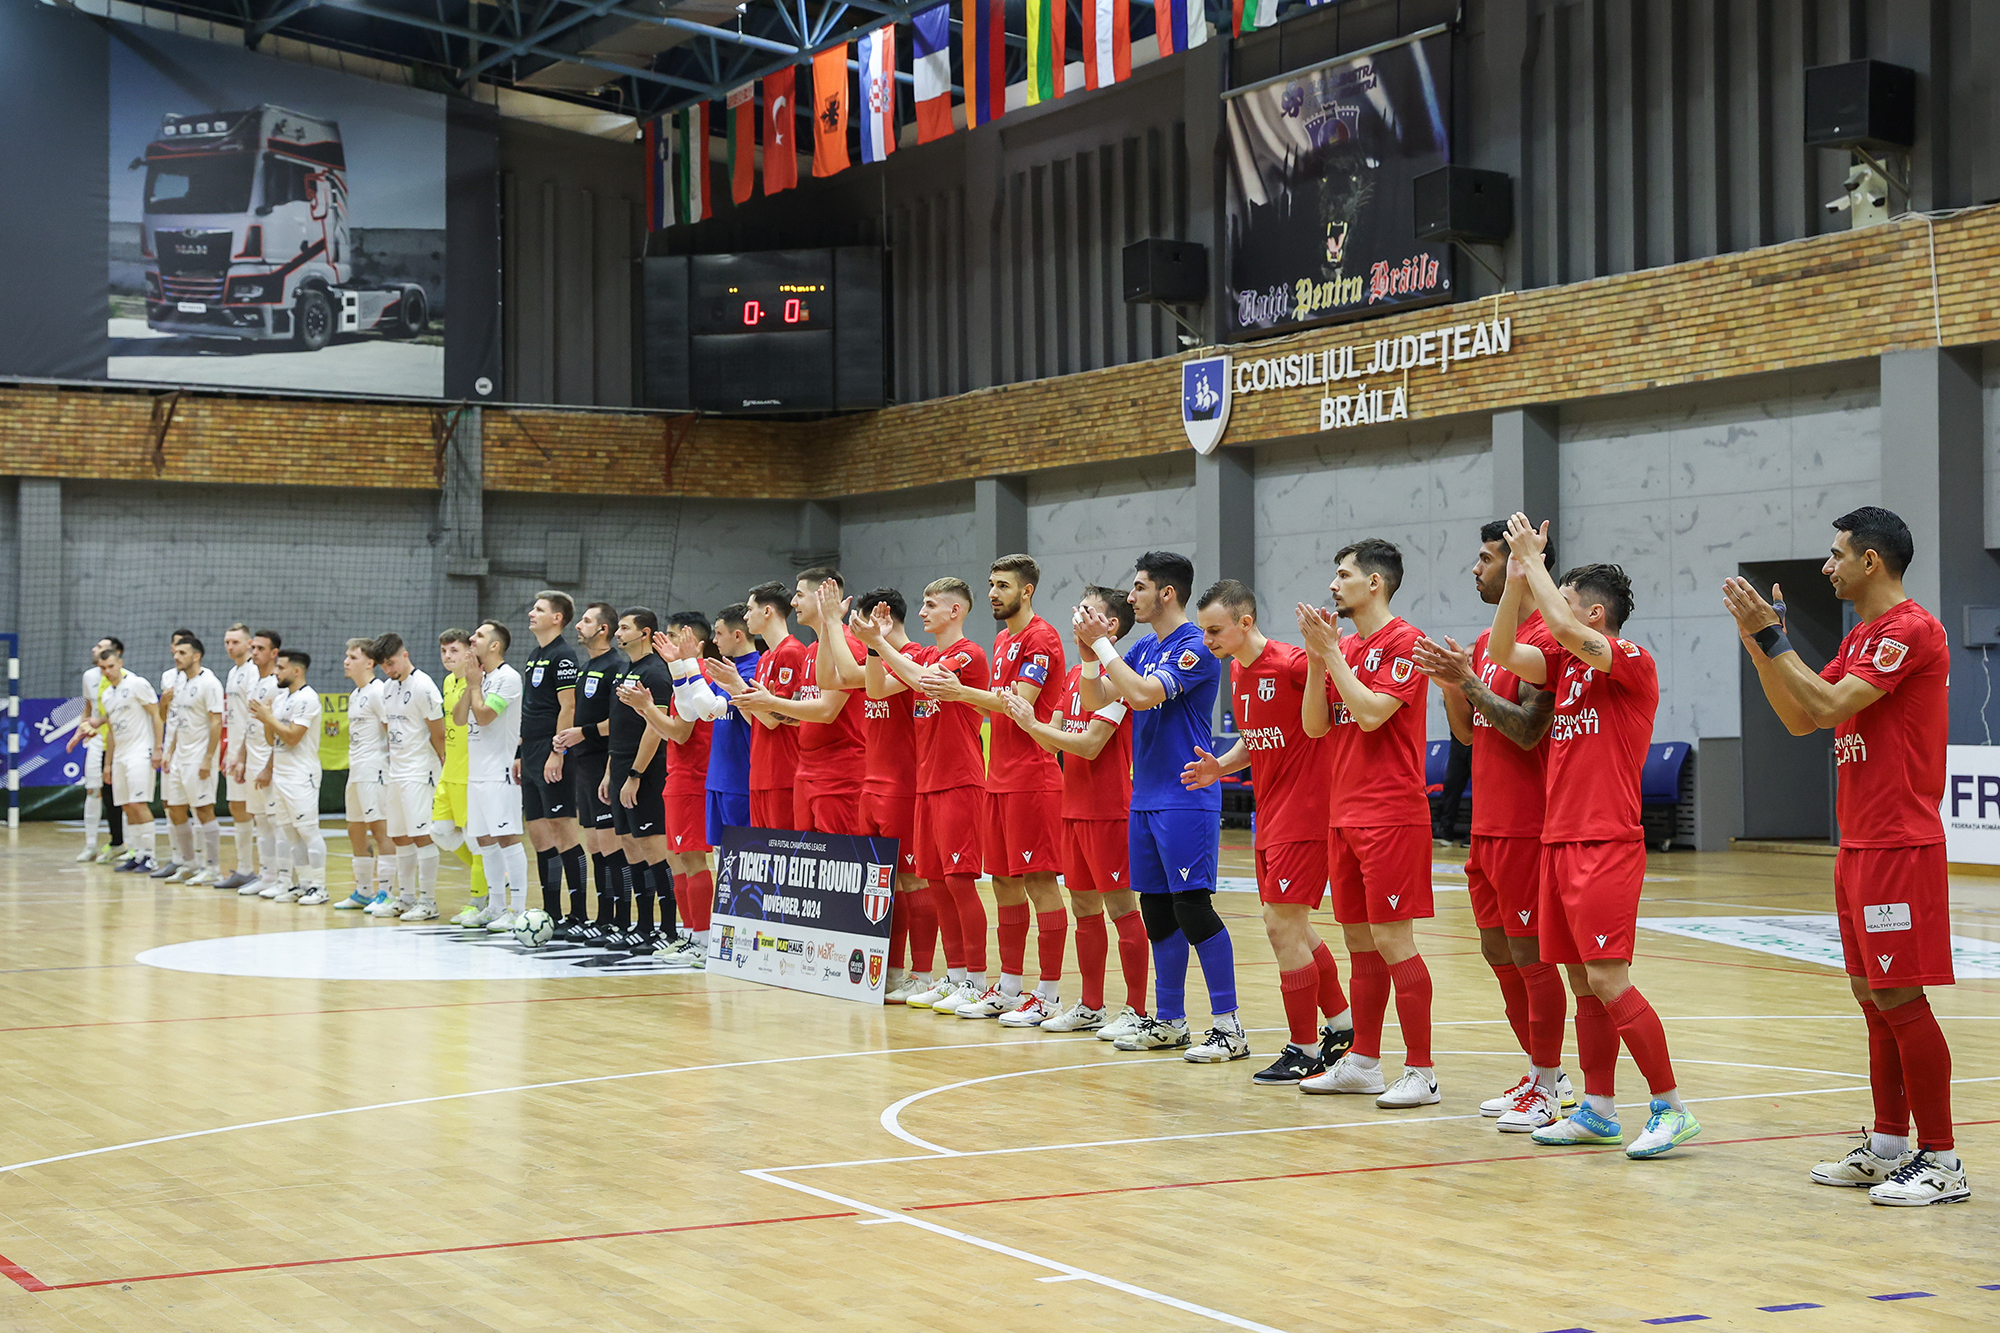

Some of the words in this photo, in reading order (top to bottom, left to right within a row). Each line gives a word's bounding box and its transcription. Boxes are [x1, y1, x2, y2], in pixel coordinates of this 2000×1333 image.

[1236, 346, 1362, 394] CONSILIUL
[1320, 383, 1408, 430] BRĂILA
[994, 657, 1003, 680] 3
[1024, 664, 1038, 677] C
[1240, 694, 1250, 722] 7
[769, 839, 779, 847] UEFA
[790, 841, 812, 851] CHAMPIONS
[811, 843, 827, 852] LEAGUE
[737, 851, 772, 883] TICKET
[772, 854, 787, 885] TO
[788, 856, 817, 889] ELITE
[818, 859, 863, 894] ROUND
[762, 894, 800, 918] NOVEMBER,
[801, 899, 821, 919] 2024
